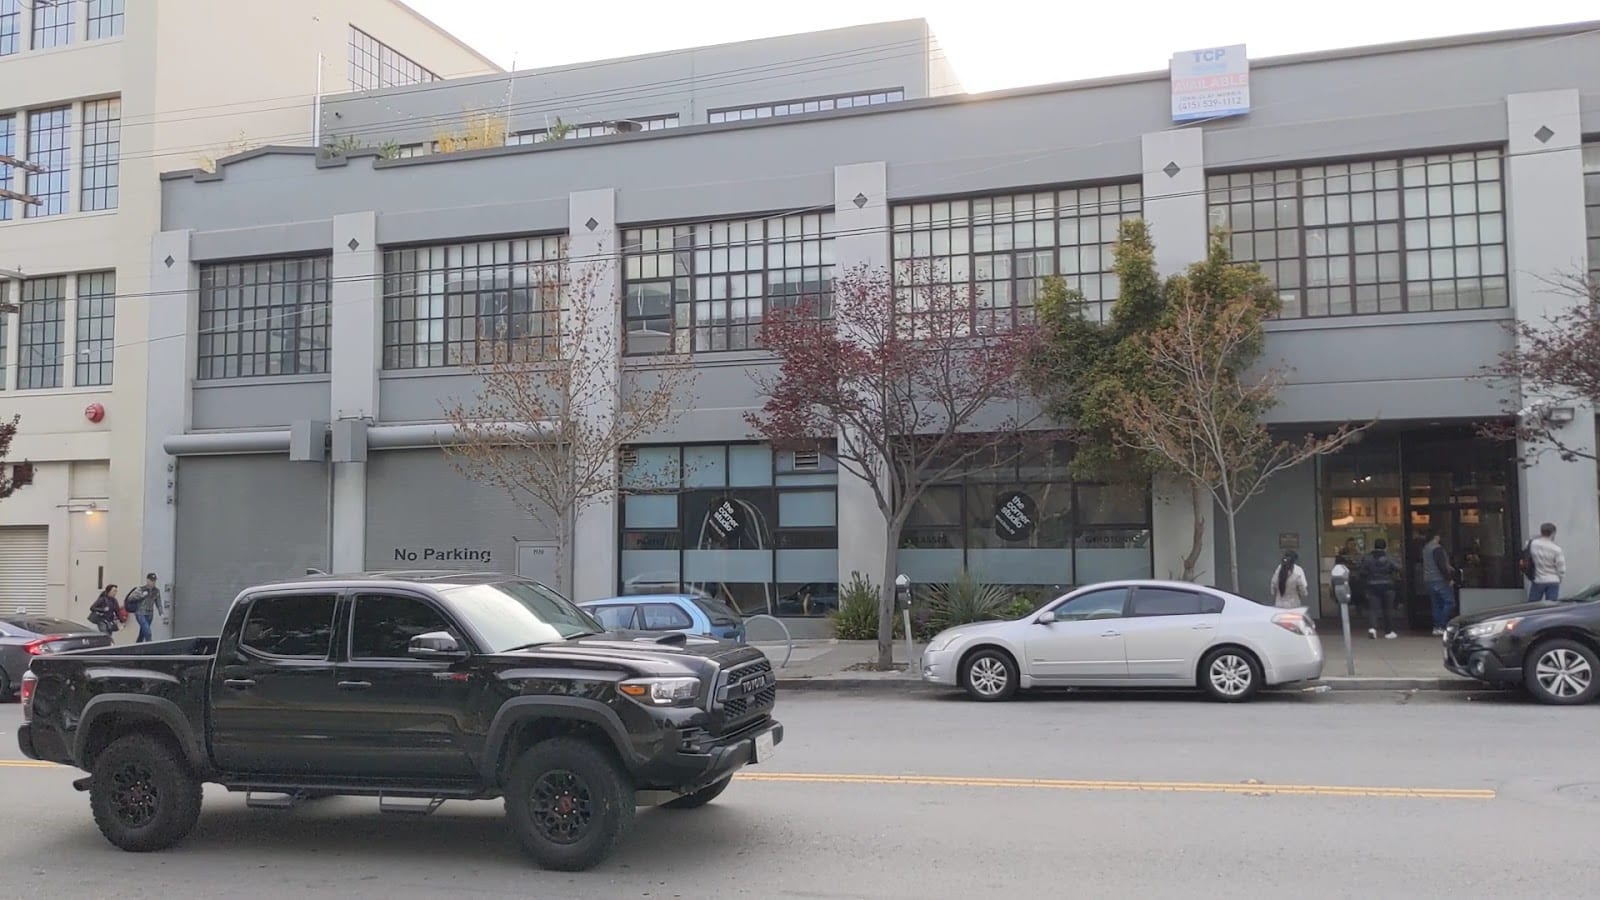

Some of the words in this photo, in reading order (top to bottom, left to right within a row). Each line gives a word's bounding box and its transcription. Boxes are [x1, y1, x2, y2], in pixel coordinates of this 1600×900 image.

[1193, 49, 1226, 63] TCP
[723, 501, 735, 514] the
[1012, 495, 1025, 510] the
[719, 507, 740, 528] corner
[1001, 506, 1023, 528] studio
[1007, 501, 1031, 524] corner
[713, 511, 732, 532] studio
[394, 548, 417, 561] No
[423, 548, 491, 563] Parking
[742, 676, 766, 693] TOYOTA
